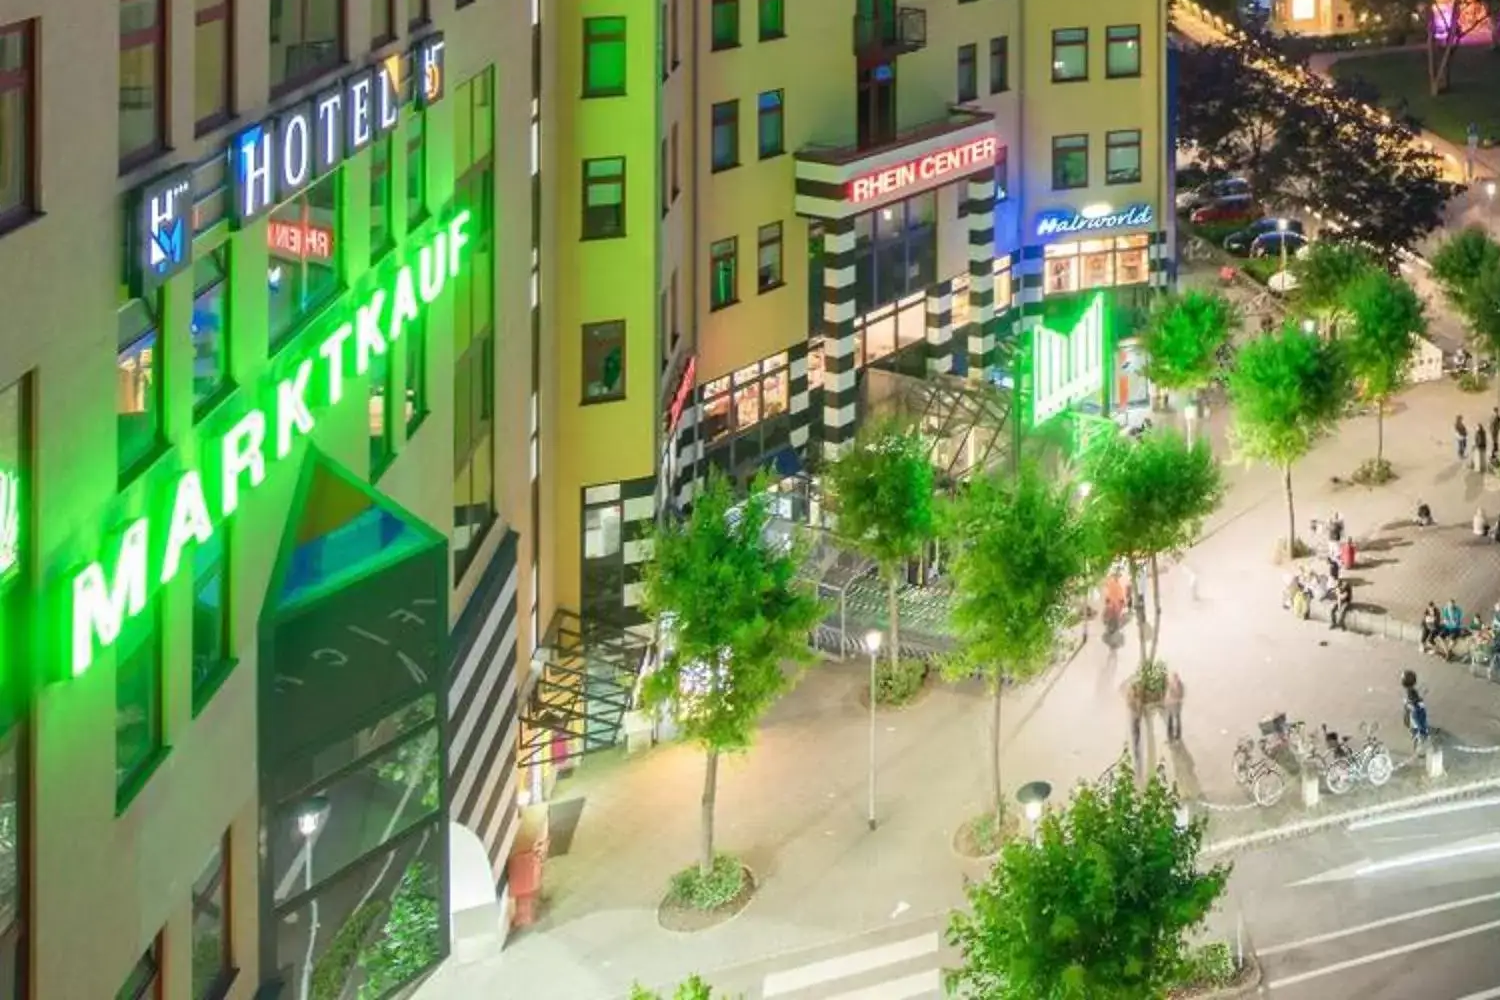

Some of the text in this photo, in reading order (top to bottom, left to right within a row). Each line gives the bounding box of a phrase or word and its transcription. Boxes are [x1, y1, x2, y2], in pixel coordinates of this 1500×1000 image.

[241, 65, 399, 217] HOTEL
[853, 137, 997, 202] RHEIN CENTER
[69, 209, 471, 678] MARKTKAUF
